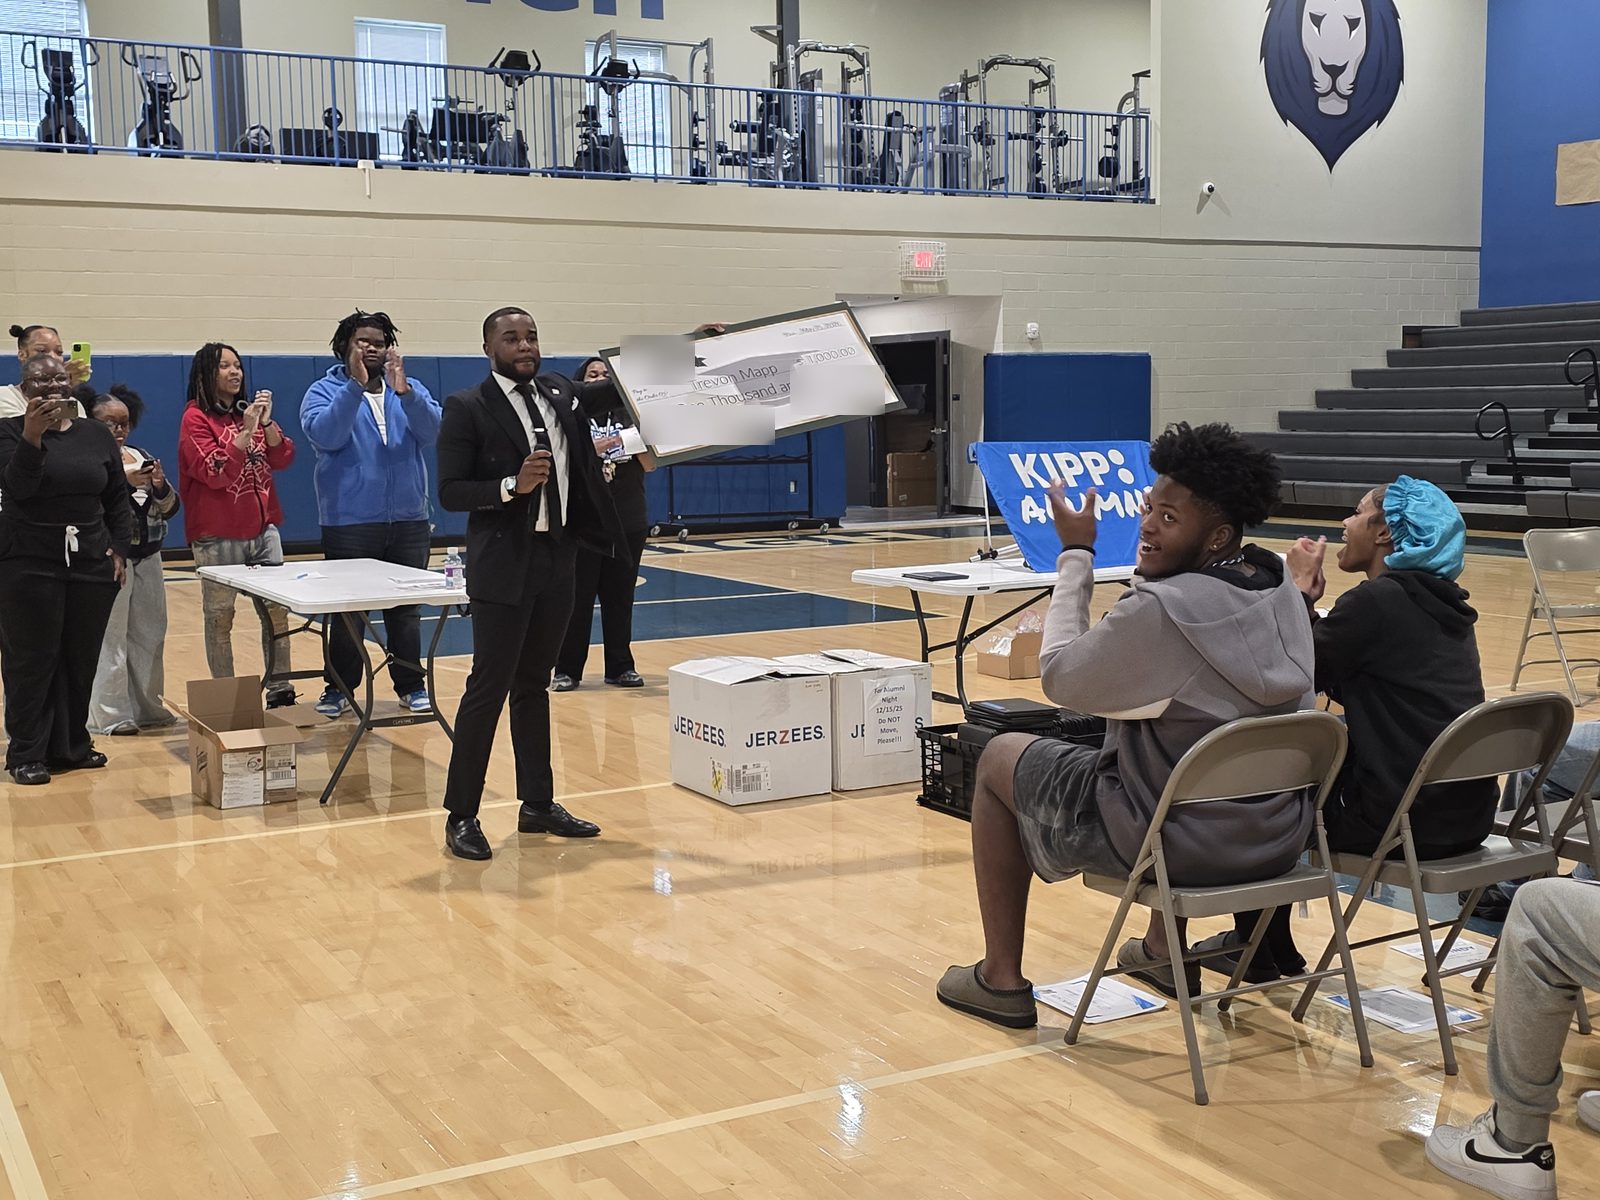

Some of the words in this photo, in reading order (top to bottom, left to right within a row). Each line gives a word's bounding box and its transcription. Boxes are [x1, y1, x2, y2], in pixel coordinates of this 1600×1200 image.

[688, 373, 738, 390] Trevon
[739, 365, 778, 380] Mapp
[706, 382, 777, 405] Thousand
[1020, 485, 1154, 525] ALUMN
[883, 685, 905, 693] Alumni
[876, 705, 903, 714] 12/15/25
